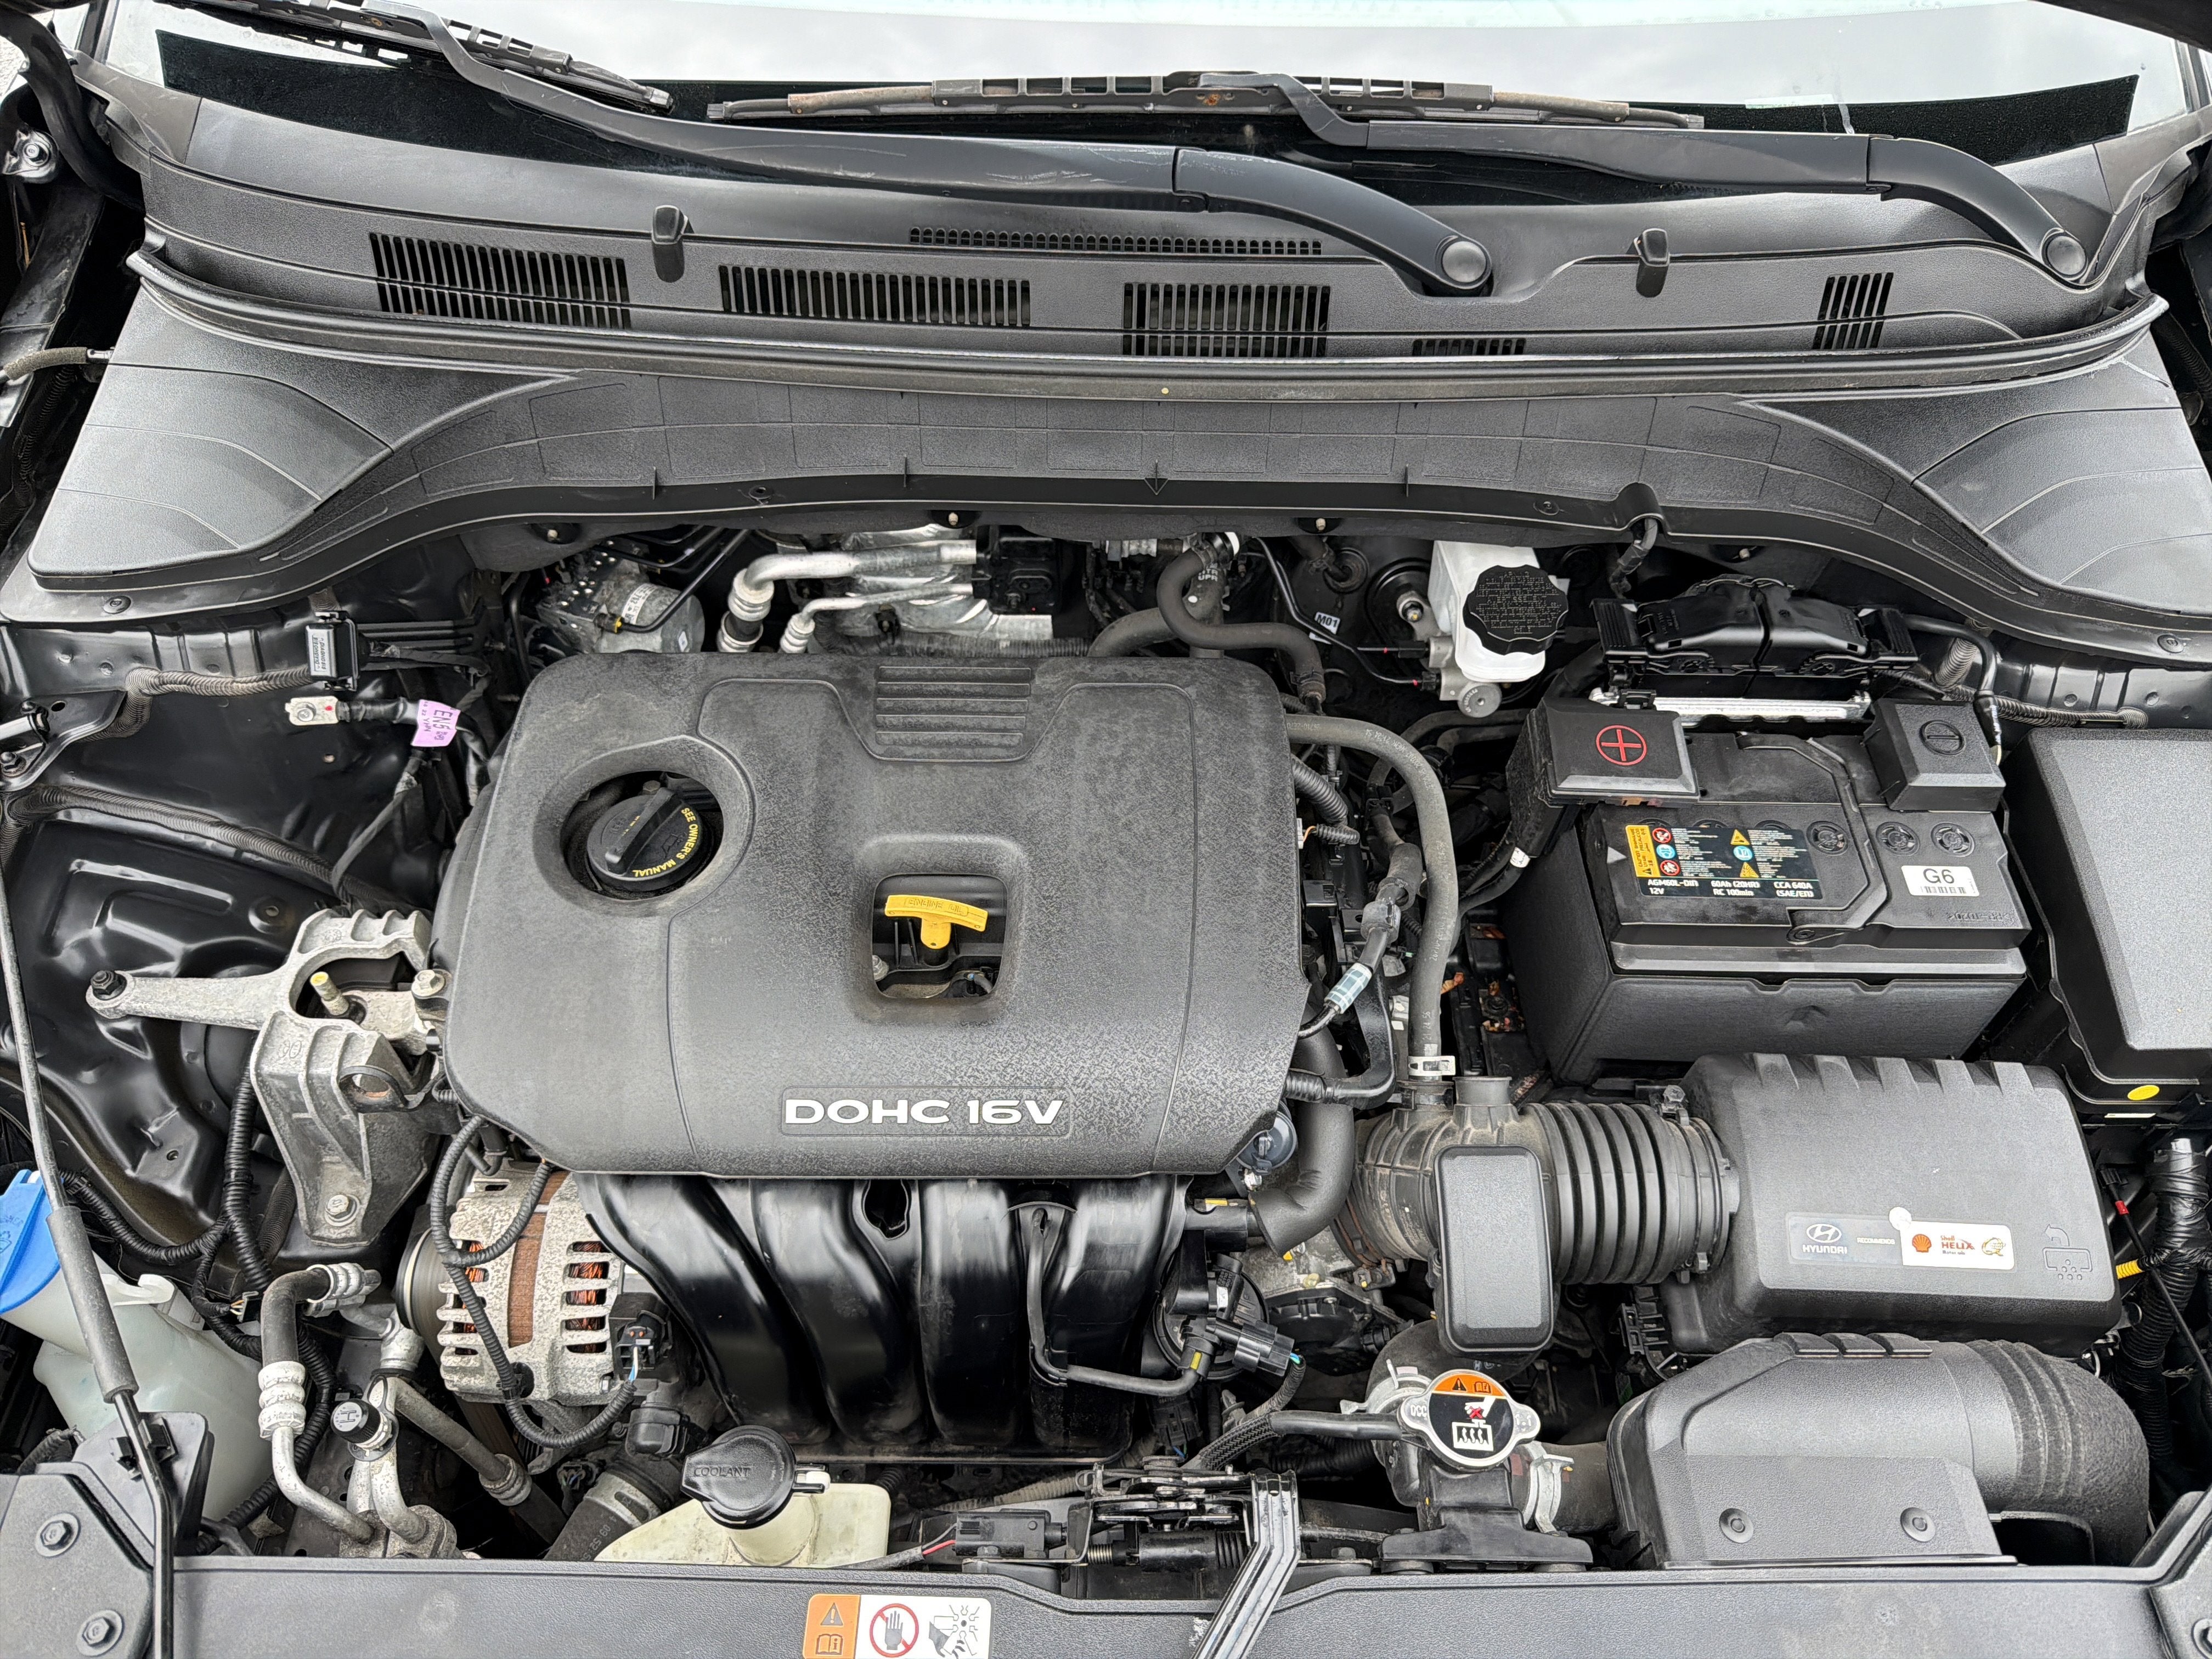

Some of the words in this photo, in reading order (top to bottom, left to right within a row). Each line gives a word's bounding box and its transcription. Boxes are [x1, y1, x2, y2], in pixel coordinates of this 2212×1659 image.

[1316, 613, 1339, 628] M01
[681, 807, 696, 822] SEE
[676, 823, 698, 860] OWNER'S
[632, 859, 676, 877] MANUAL
[1923, 868, 1955, 884] G6
[1711, 880, 1731, 888] 60Ah
[1733, 880, 1760, 889] (20HR)
[1774, 881, 1791, 889] CCA
[1776, 889, 1814, 898] (SAE/EN)
[908, 898, 944, 909] ENGINE
[949, 904, 963, 913] OIL
[785, 1099, 950, 1124] DOHC
[967, 1099, 1064, 1125] 16V
[1856, 1237, 1895, 1245] RECOMMENDS
[1942, 1242, 1975, 1250] HELIX
[1803, 1244, 1848, 1255] HYUNDAI
[1514, 1413, 1532, 1426] 1.1
[693, 1466, 751, 1477] COOLANT
